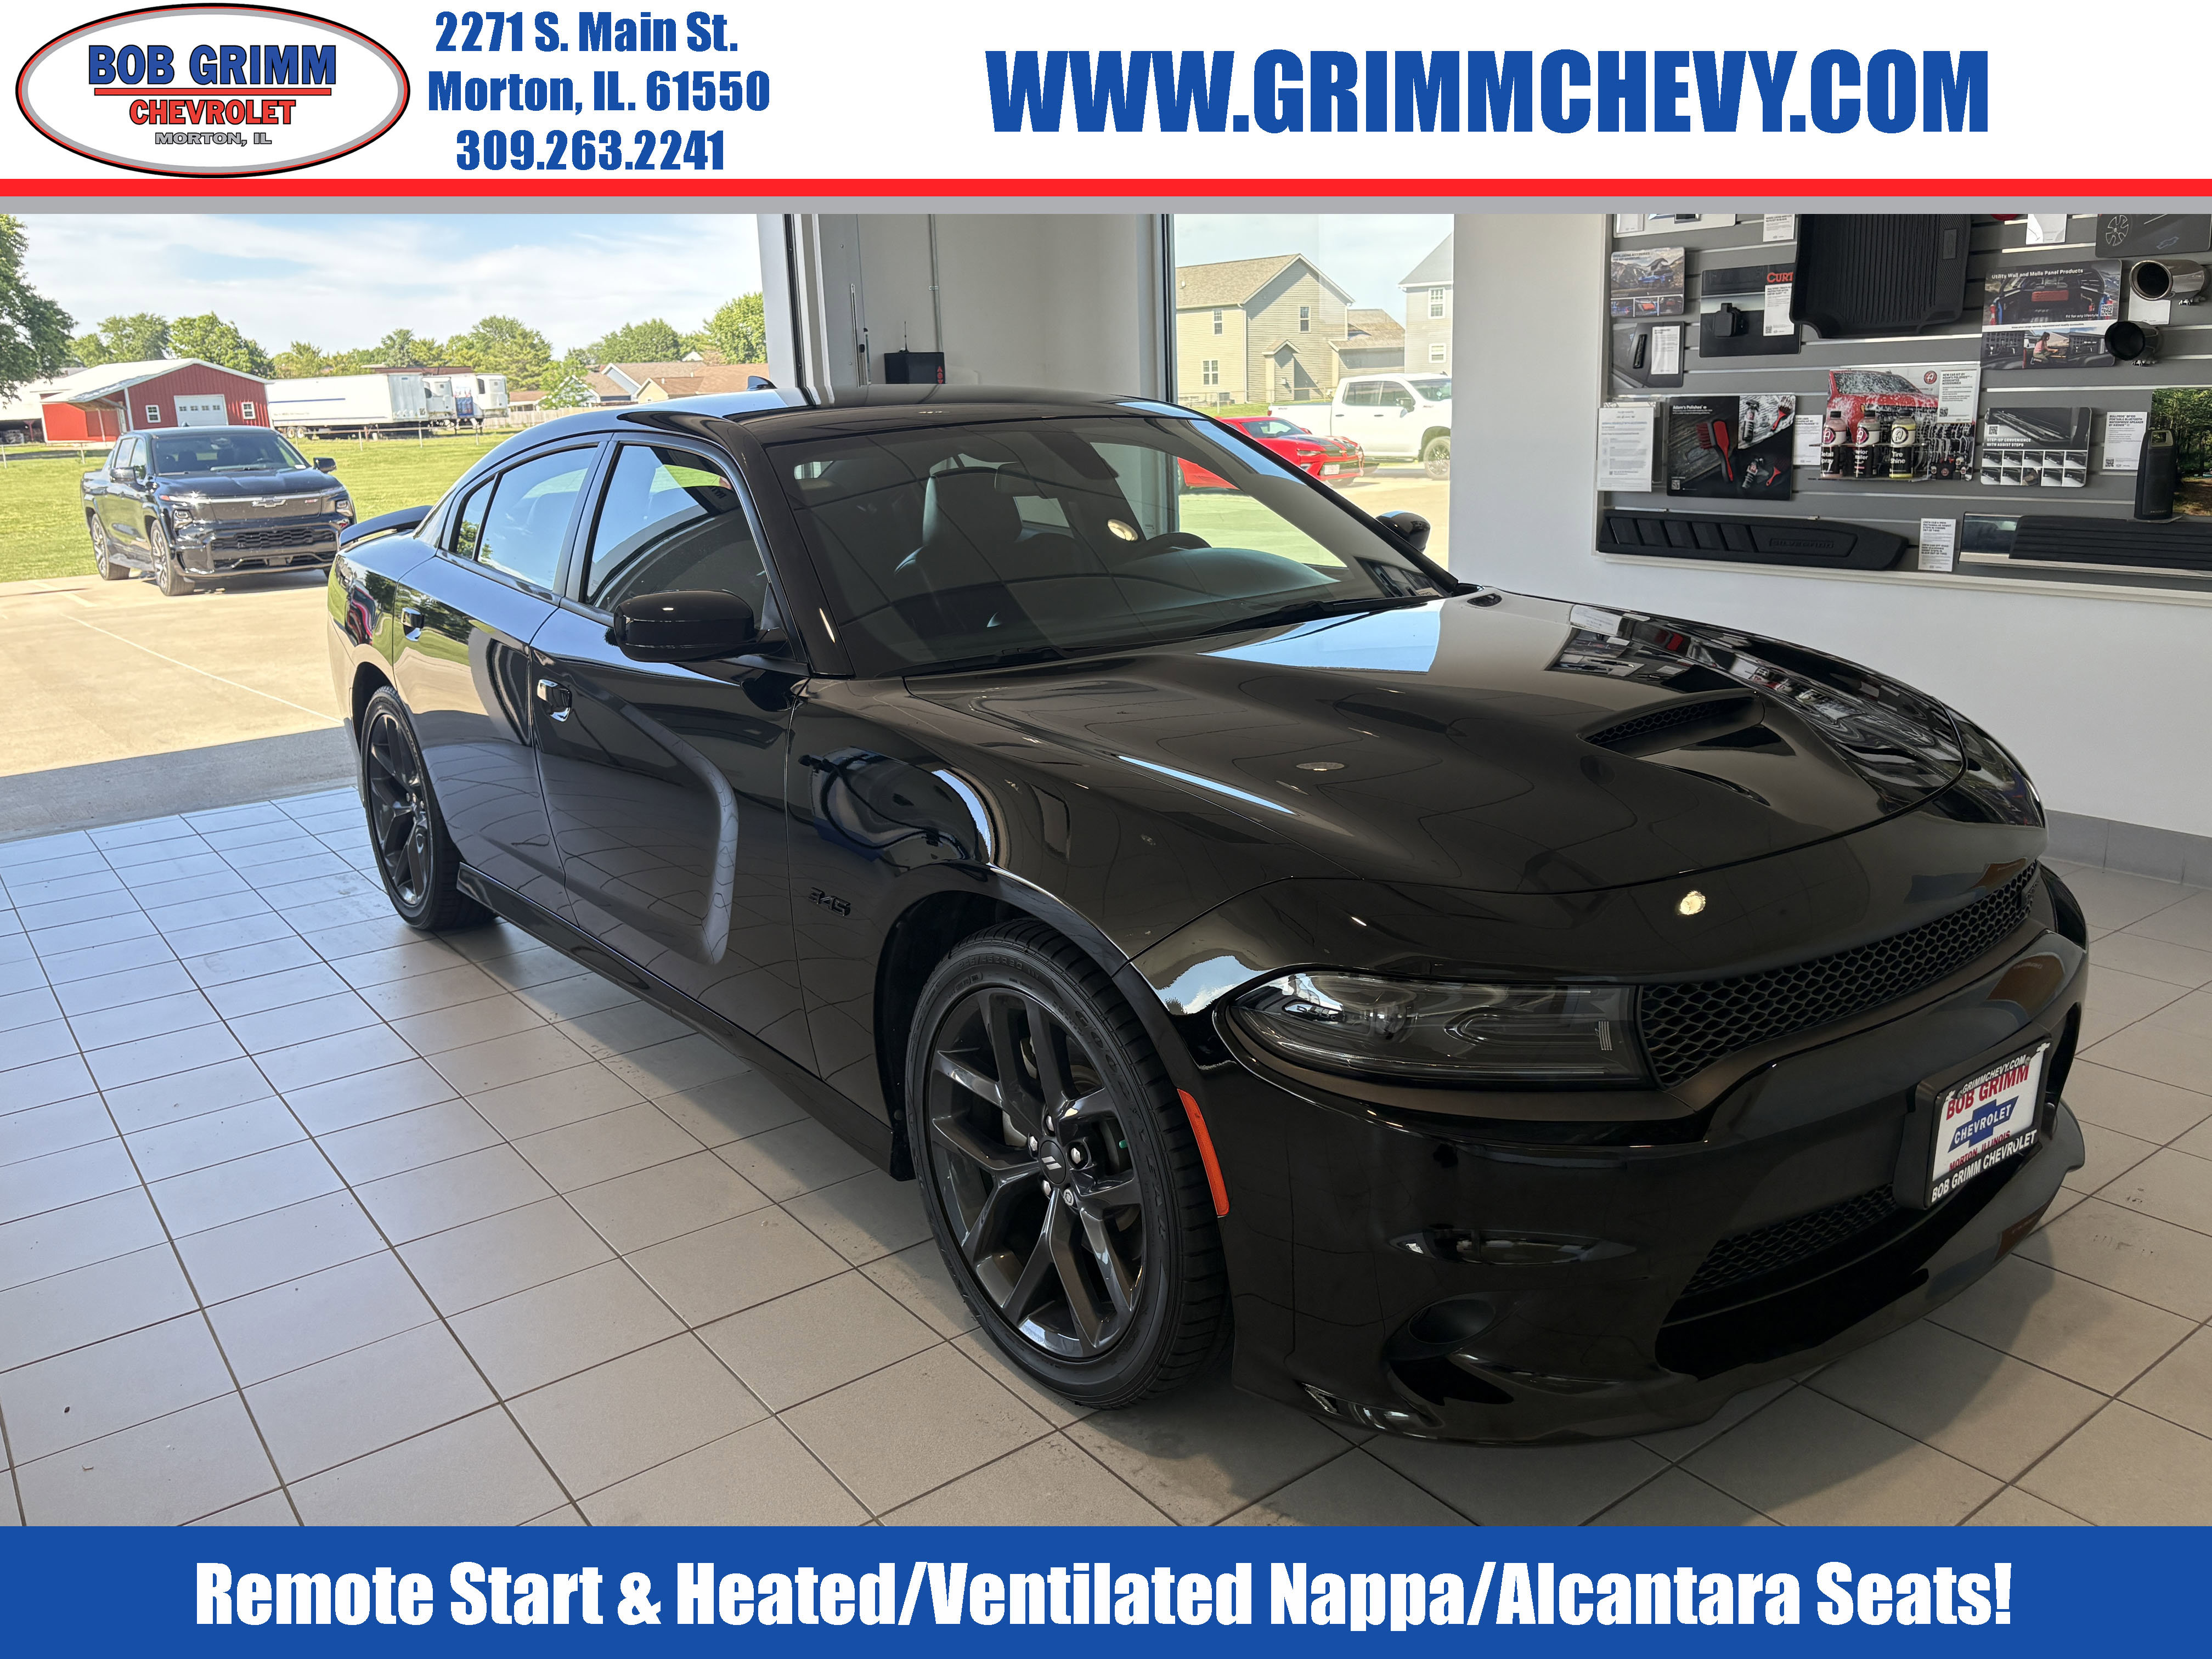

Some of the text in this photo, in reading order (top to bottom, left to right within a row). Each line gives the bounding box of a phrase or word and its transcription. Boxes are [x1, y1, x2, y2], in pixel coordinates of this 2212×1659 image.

[808, 887, 851, 916] 345
[1946, 1065, 2029, 1120] BOB GRIMM
[1962, 1054, 2027, 1092] GRIMMCHEVY.COM
[1954, 1104, 2012, 1144] CHEVROLET
[1982, 1130, 2011, 1152] ILLINOIS
[1932, 1129, 2038, 1203] BOB GRIMM CHEVROLET
